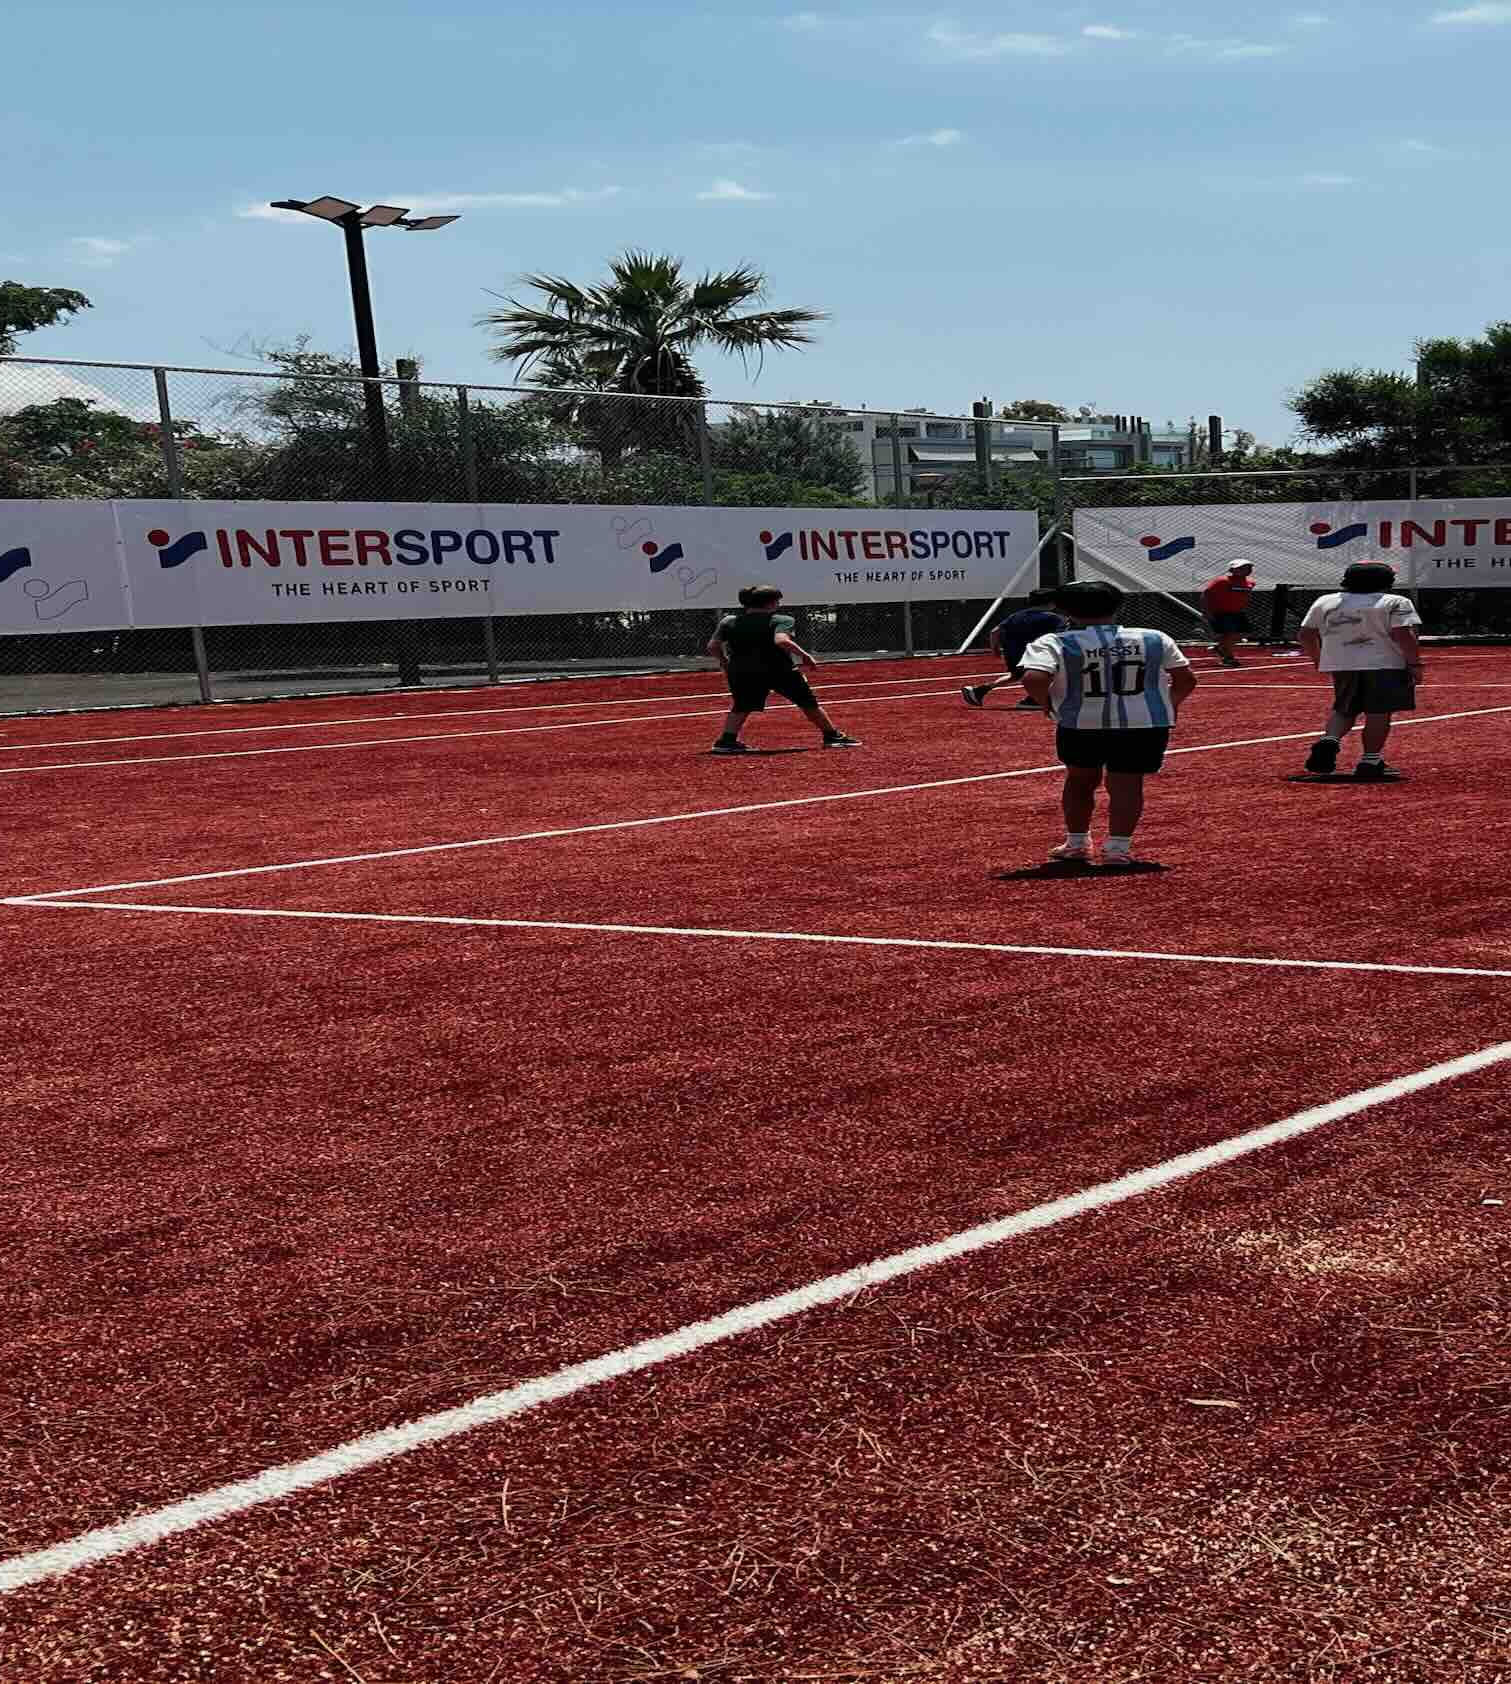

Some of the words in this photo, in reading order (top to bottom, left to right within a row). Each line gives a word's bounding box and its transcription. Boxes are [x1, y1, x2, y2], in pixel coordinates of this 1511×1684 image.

[216, 529, 560, 567] INTERSPORT
[799, 530, 1011, 560] INTERSPORT
[1432, 558, 1477, 568] THE
[272, 583, 311, 597] THE
[322, 581, 388, 595] HEART
[397, 580, 420, 593] OF
[429, 578, 491, 592] SPORT
[834, 572, 859, 583] THE
[866, 570, 905, 582] HEART
[911, 570, 924, 581] OF
[929, 569, 966, 581] SPORT
[1082, 660, 1144, 697] 10
